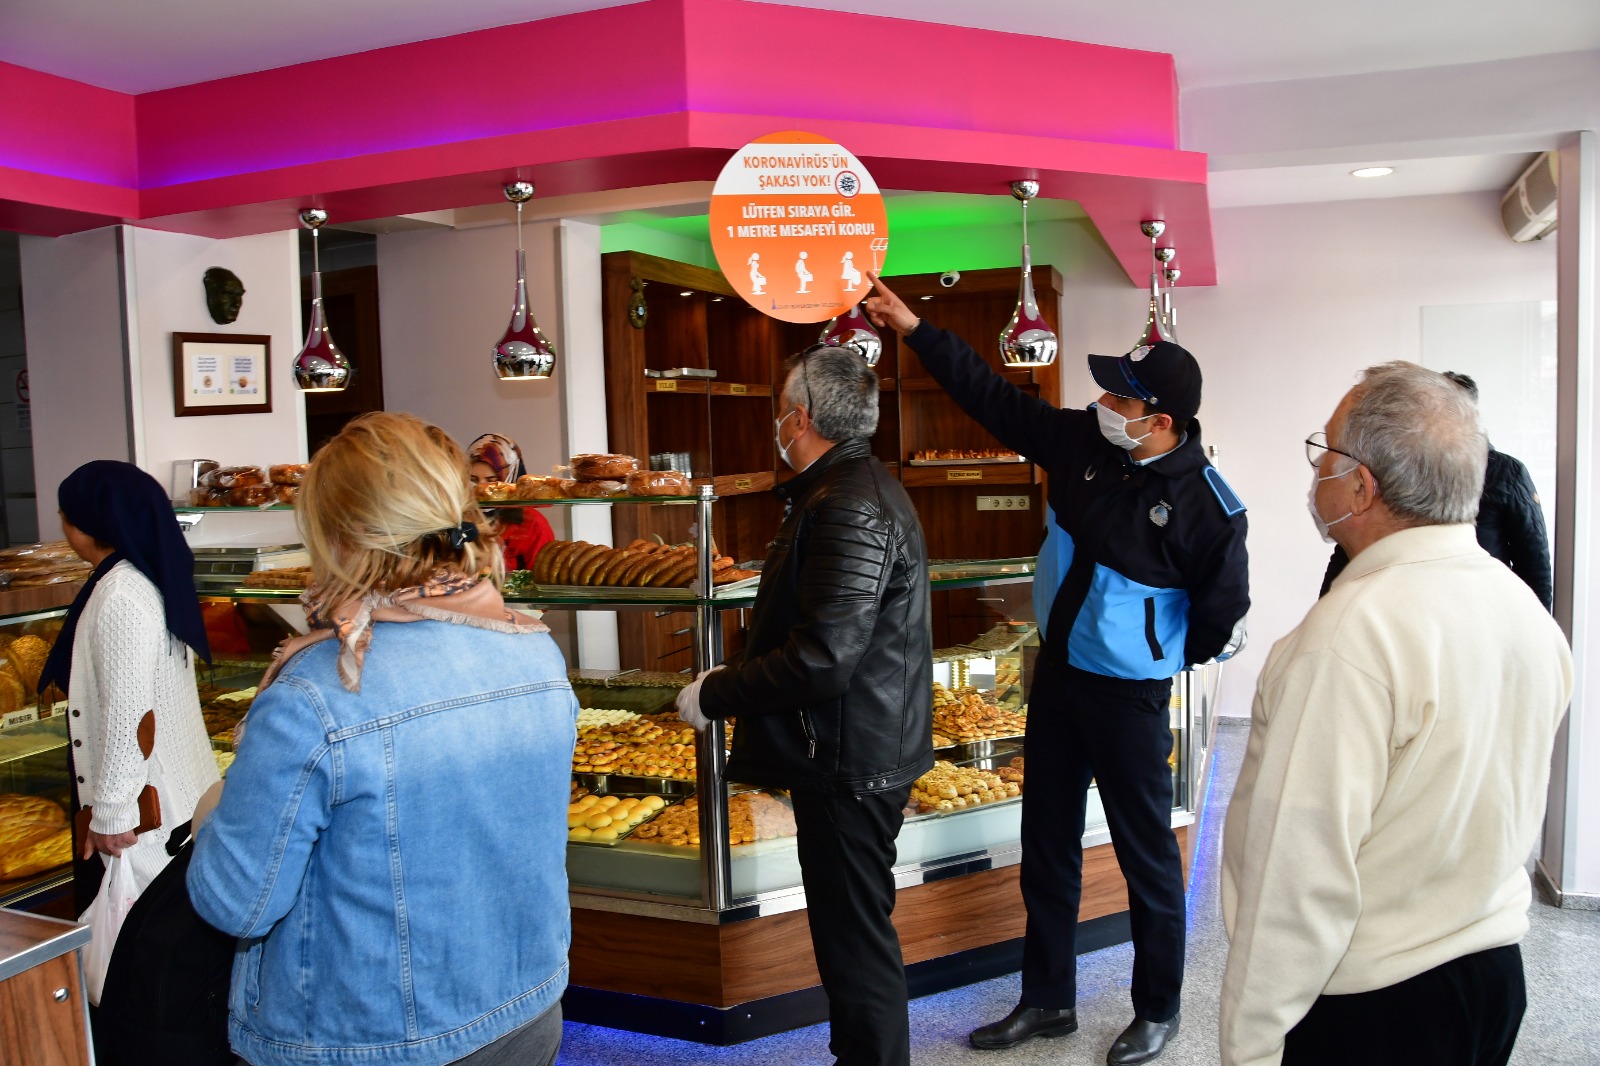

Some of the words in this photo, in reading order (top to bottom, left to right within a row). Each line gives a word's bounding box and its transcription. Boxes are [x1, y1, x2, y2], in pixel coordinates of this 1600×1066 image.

[743, 153, 848, 169] KORONAVİRÜS'ÜN
[759, 174, 801, 190] ŞAKASI
[803, 174, 831, 187] YOK!
[742, 202, 786, 219] LÜTFEN
[788, 205, 830, 218] SIRAYA
[831, 202, 856, 217] GİR.
[726, 226, 734, 238] 1
[737, 225, 778, 238] METRE
[780, 220, 836, 237] MESAFEYİ
[839, 223, 875, 236] KORU!
[8, 714, 32, 725] MISIR
